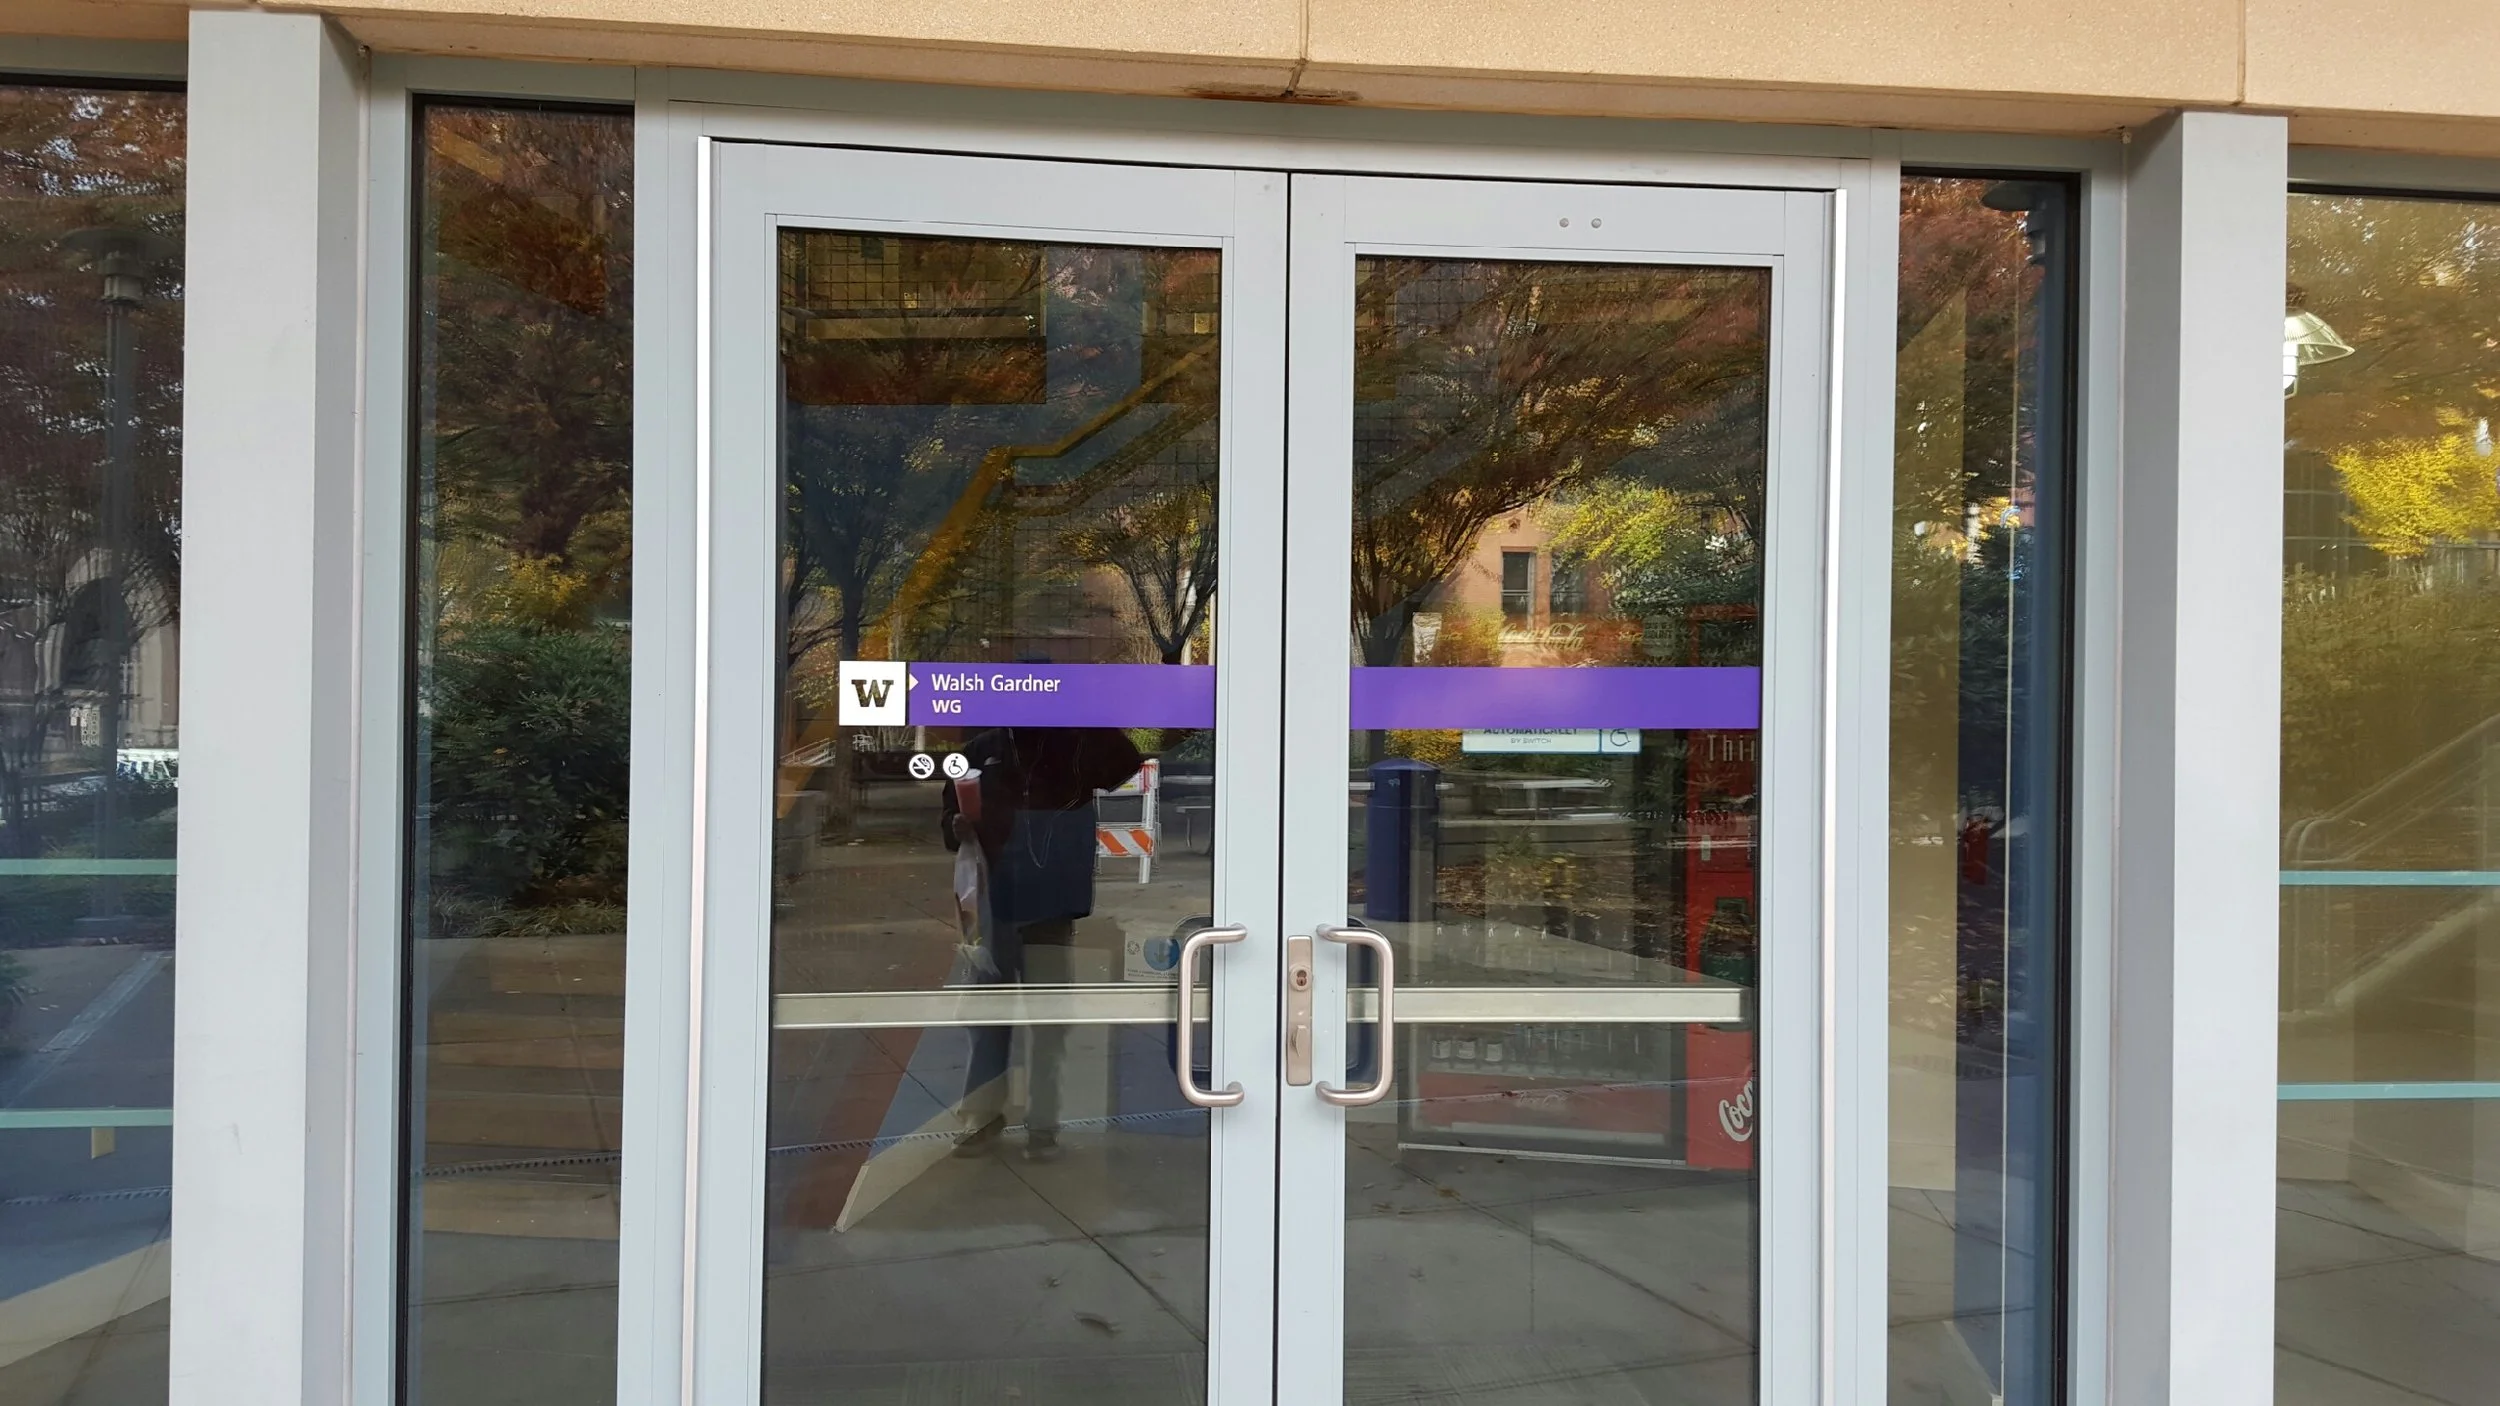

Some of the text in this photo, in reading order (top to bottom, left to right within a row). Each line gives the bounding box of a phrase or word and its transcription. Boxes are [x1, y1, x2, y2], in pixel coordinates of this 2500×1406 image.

[931, 673, 1061, 692] Walsh Gardner
[851, 679, 894, 707] W
[932, 699, 962, 714] WG
